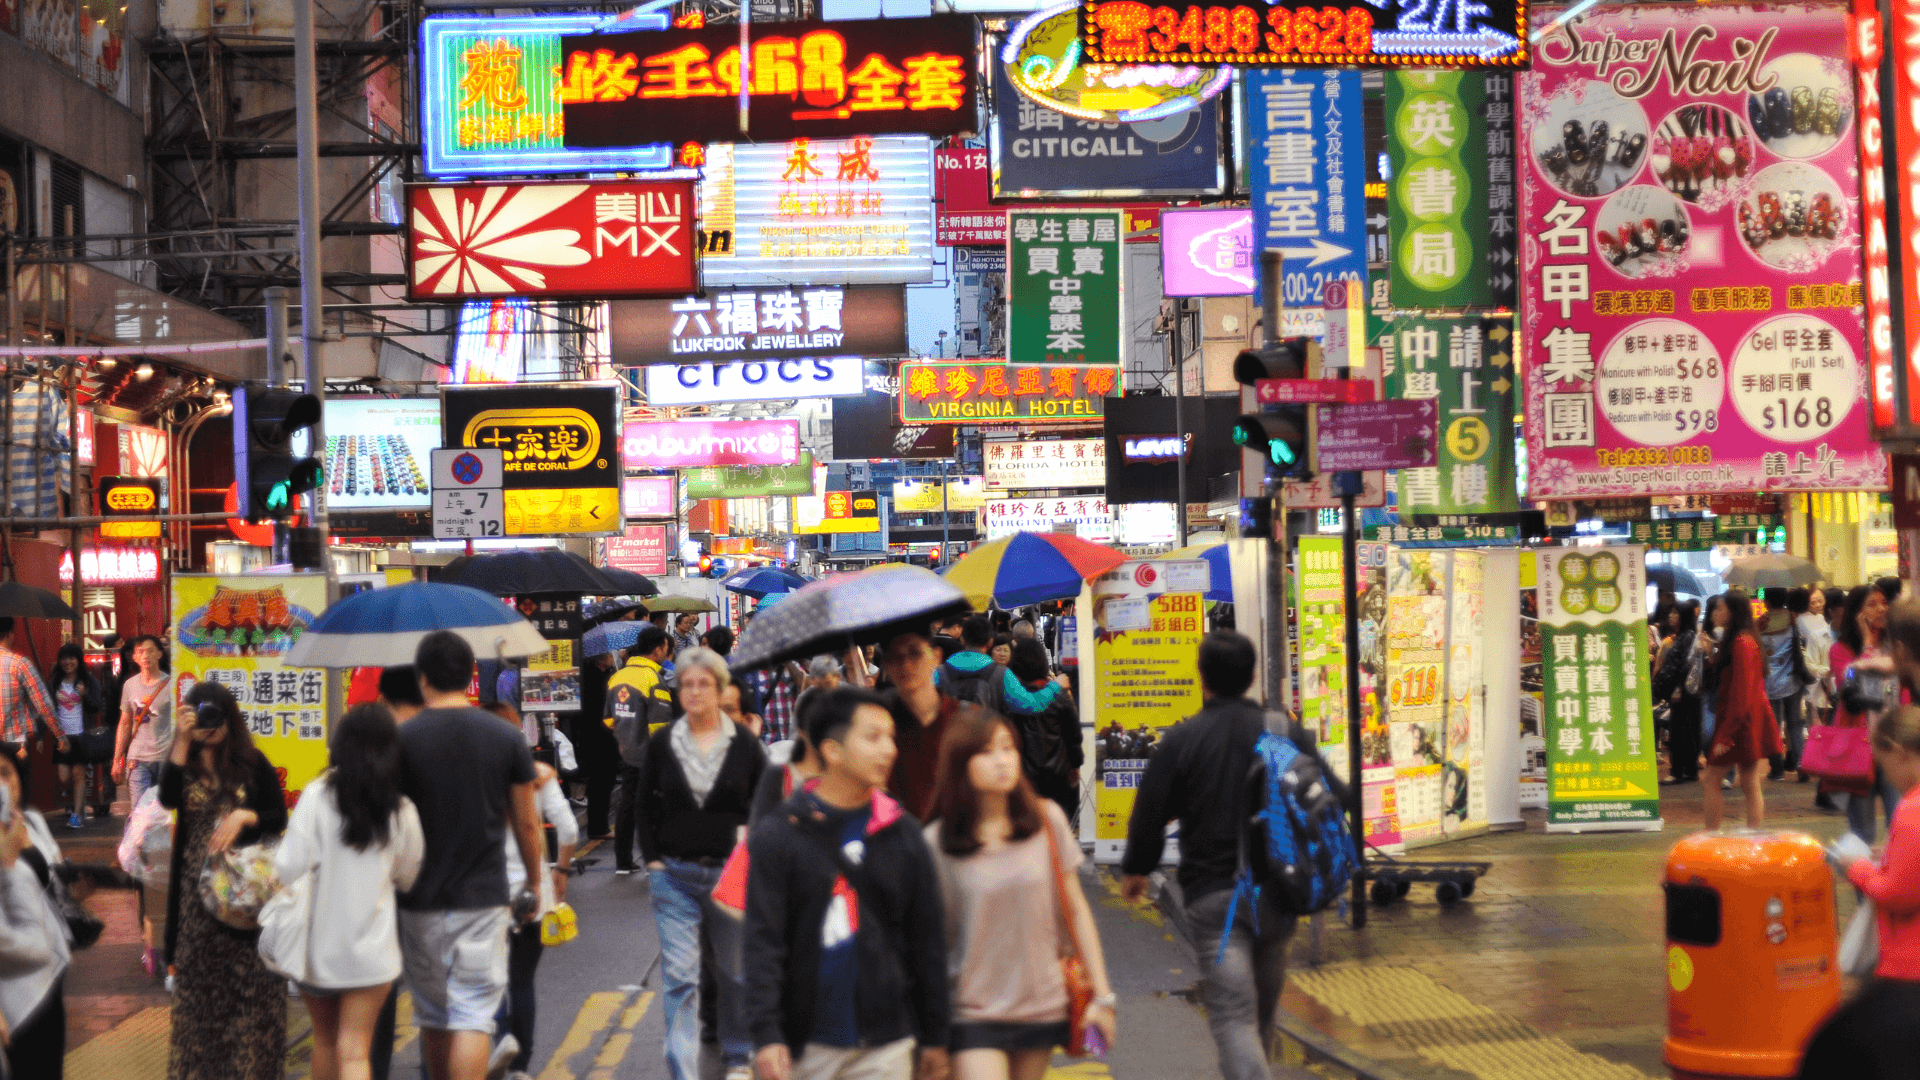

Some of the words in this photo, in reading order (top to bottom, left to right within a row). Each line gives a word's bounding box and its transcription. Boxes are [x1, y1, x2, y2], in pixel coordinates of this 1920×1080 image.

[1151, 5, 1259, 53] 3488
[1265, 6, 1374, 54] 3628
[1540, 15, 1658, 76] Super
[1611, 25, 1780, 98] Nail
[1012, 136, 1143, 158] CITICALL
[1261, 69, 1320, 238] 言書室
[1485, 75, 1513, 238] 中學新舊課本
[781, 137, 880, 183] 永成
[1408, 71, 1456, 277] 英書局
[595, 192, 681, 224] 美心
[1858, 17, 1893, 400] EXCHANGE
[596, 225, 681, 257] MX
[759, 225, 794, 236] Nikon
[800, 224, 866, 236] Authorized
[1014, 218, 1116, 242] 學生書屋
[1593, 289, 1675, 315] 環境舒適
[1690, 285, 1771, 312] 優質服務
[672, 290, 843, 336] 六福珠寶
[1046, 276, 1085, 353] 中學課本
[1538, 198, 1596, 449] 名甲集團
[672, 337, 746, 352] LUKFOOK
[752, 333, 844, 349] JEWELLERY
[1751, 331, 1777, 351] Gel
[1783, 328, 1834, 351] 甲全套
[677, 356, 835, 389] crocs
[1601, 367, 1636, 380] Manicure
[1636, 366, 1653, 378] with
[1654, 365, 1675, 377] Polish
[1677, 357, 1719, 381] $68
[1790, 357, 1815, 370] (Full
[1821, 356, 1845, 369] Set)
[908, 367, 1115, 399] 維珍尼亞賓館
[1741, 373, 1813, 394] 手腳同價
[928, 400, 1015, 417] VIRGINIA
[1029, 400, 1096, 415] HOTEL
[1608, 412, 1638, 424] Pedicure
[1639, 411, 1653, 423] with
[1654, 410, 1672, 423] Polish
[1675, 408, 1718, 433] $98
[1762, 396, 1832, 430] $168
[624, 434, 758, 457] colourmix
[989, 444, 1106, 460] 佛羅里達賓館
[1672, 445, 1711, 465] 0188
[504, 461, 522, 471] AFÉ
[524, 462, 537, 471] DE
[538, 461, 569, 470] CORAL
[988, 461, 1050, 470] FLORIDA
[1576, 464, 1734, 486] www.SuperNail.com.hk
[444, 499, 465, 509] 上午
[477, 492, 488, 508] 7
[437, 517, 474, 525] midnight
[479, 520, 500, 536] 12
[991, 518, 1055, 528] VIRGINIA
[1634, 520, 1715, 541] 學生書屋
[99, 570, 156, 580] EXCHANGE
[1157, 595, 1197, 612] 588
[205, 669, 246, 683] (第三段)
[252, 670, 323, 705] 通菜街
[1391, 665, 1437, 706] $118
[1552, 634, 1582, 756] 買賣中學
[1584, 633, 1613, 756] 新舊課本
